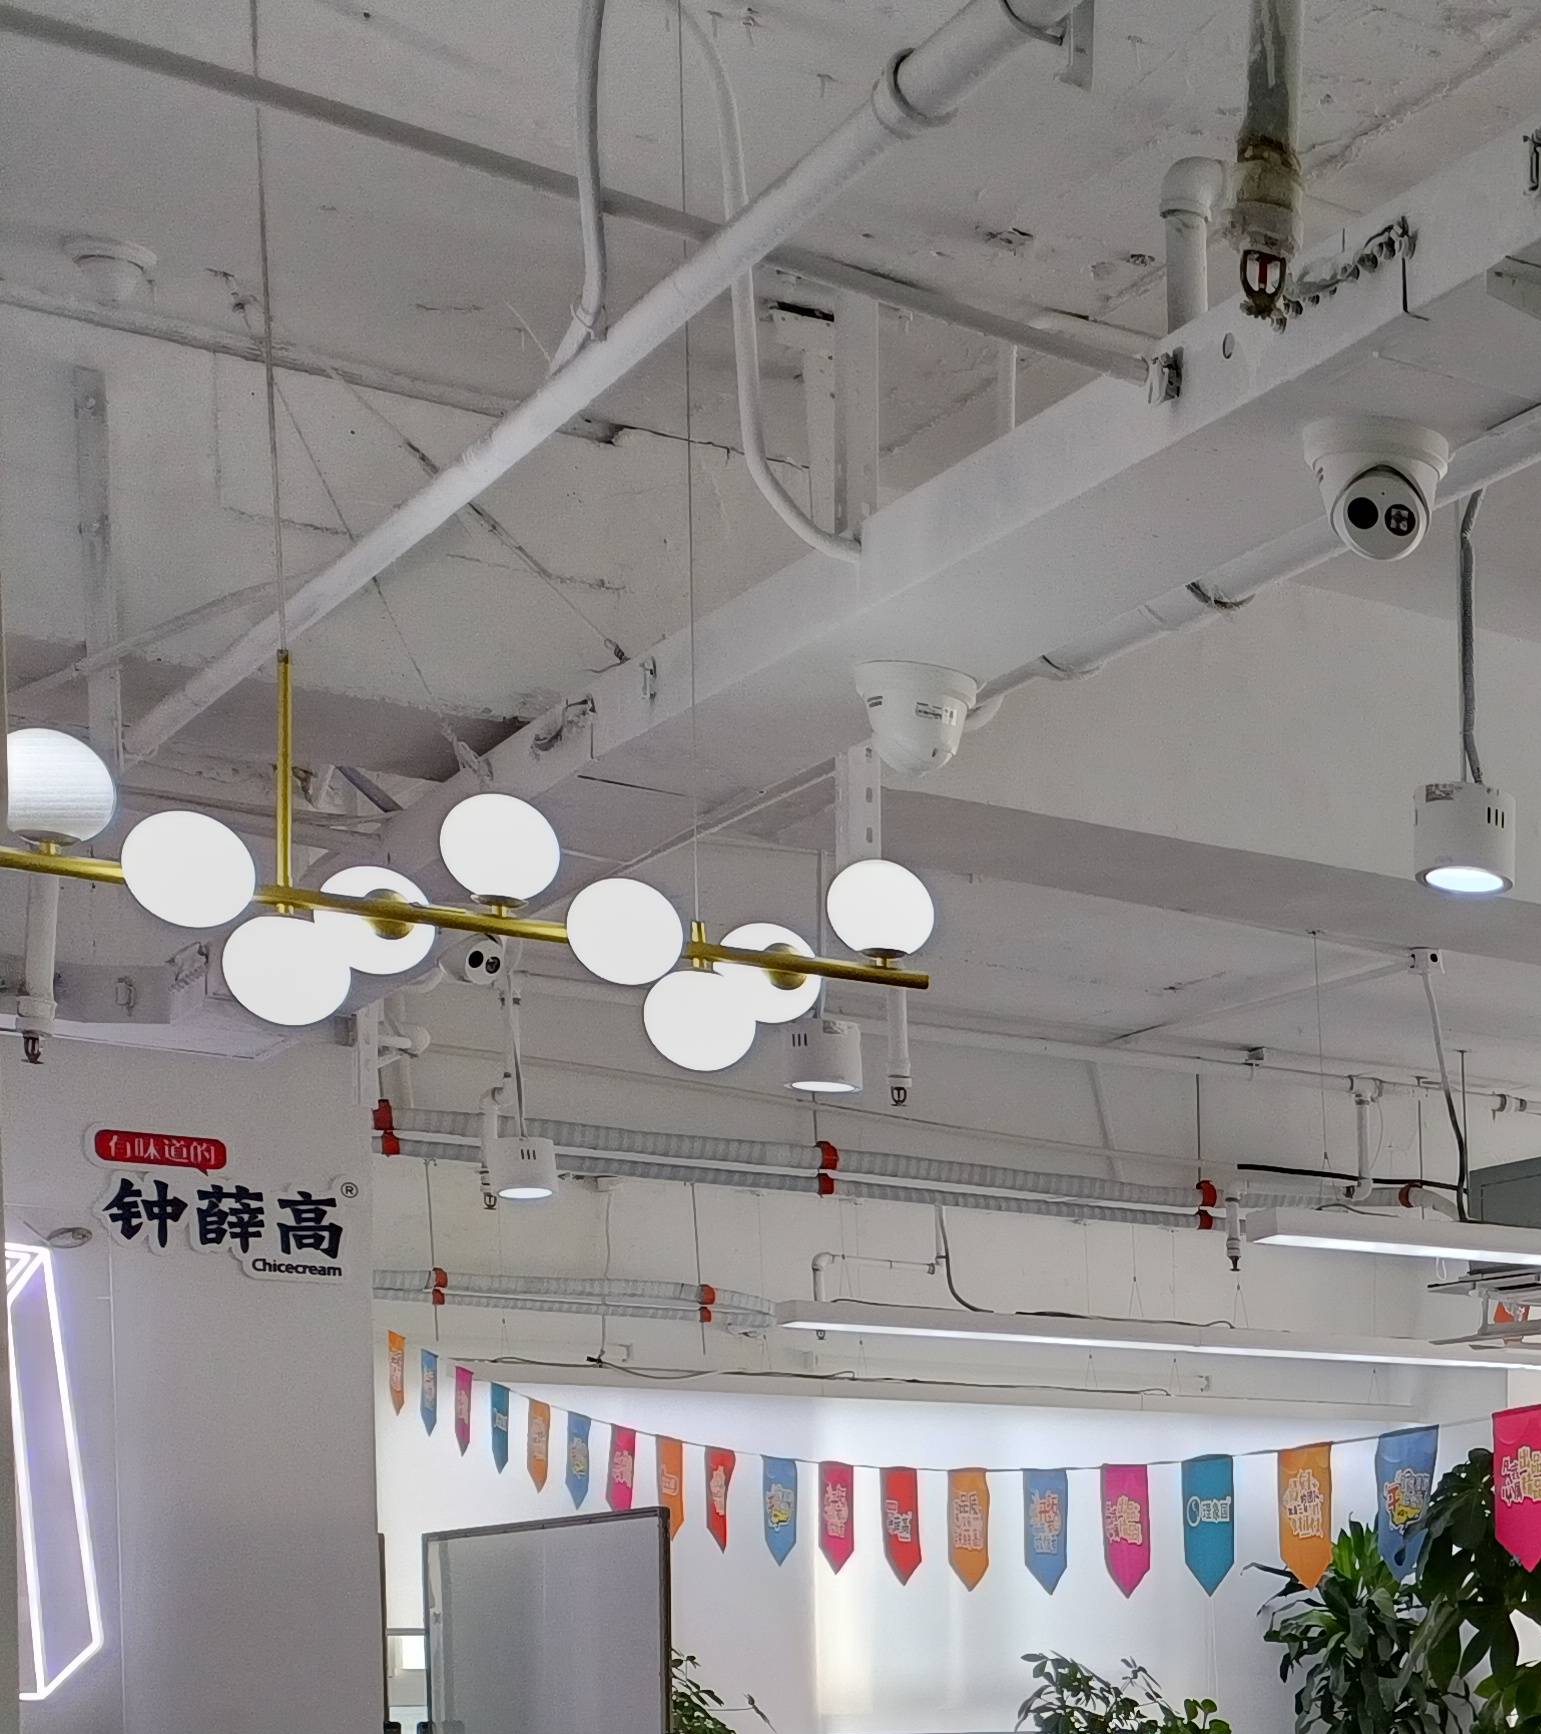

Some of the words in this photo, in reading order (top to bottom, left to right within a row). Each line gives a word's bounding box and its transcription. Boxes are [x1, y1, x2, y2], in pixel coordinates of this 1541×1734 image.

[103, 1177, 344, 1259] 钟薛高
[252, 1258, 343, 1277] Chicecream
